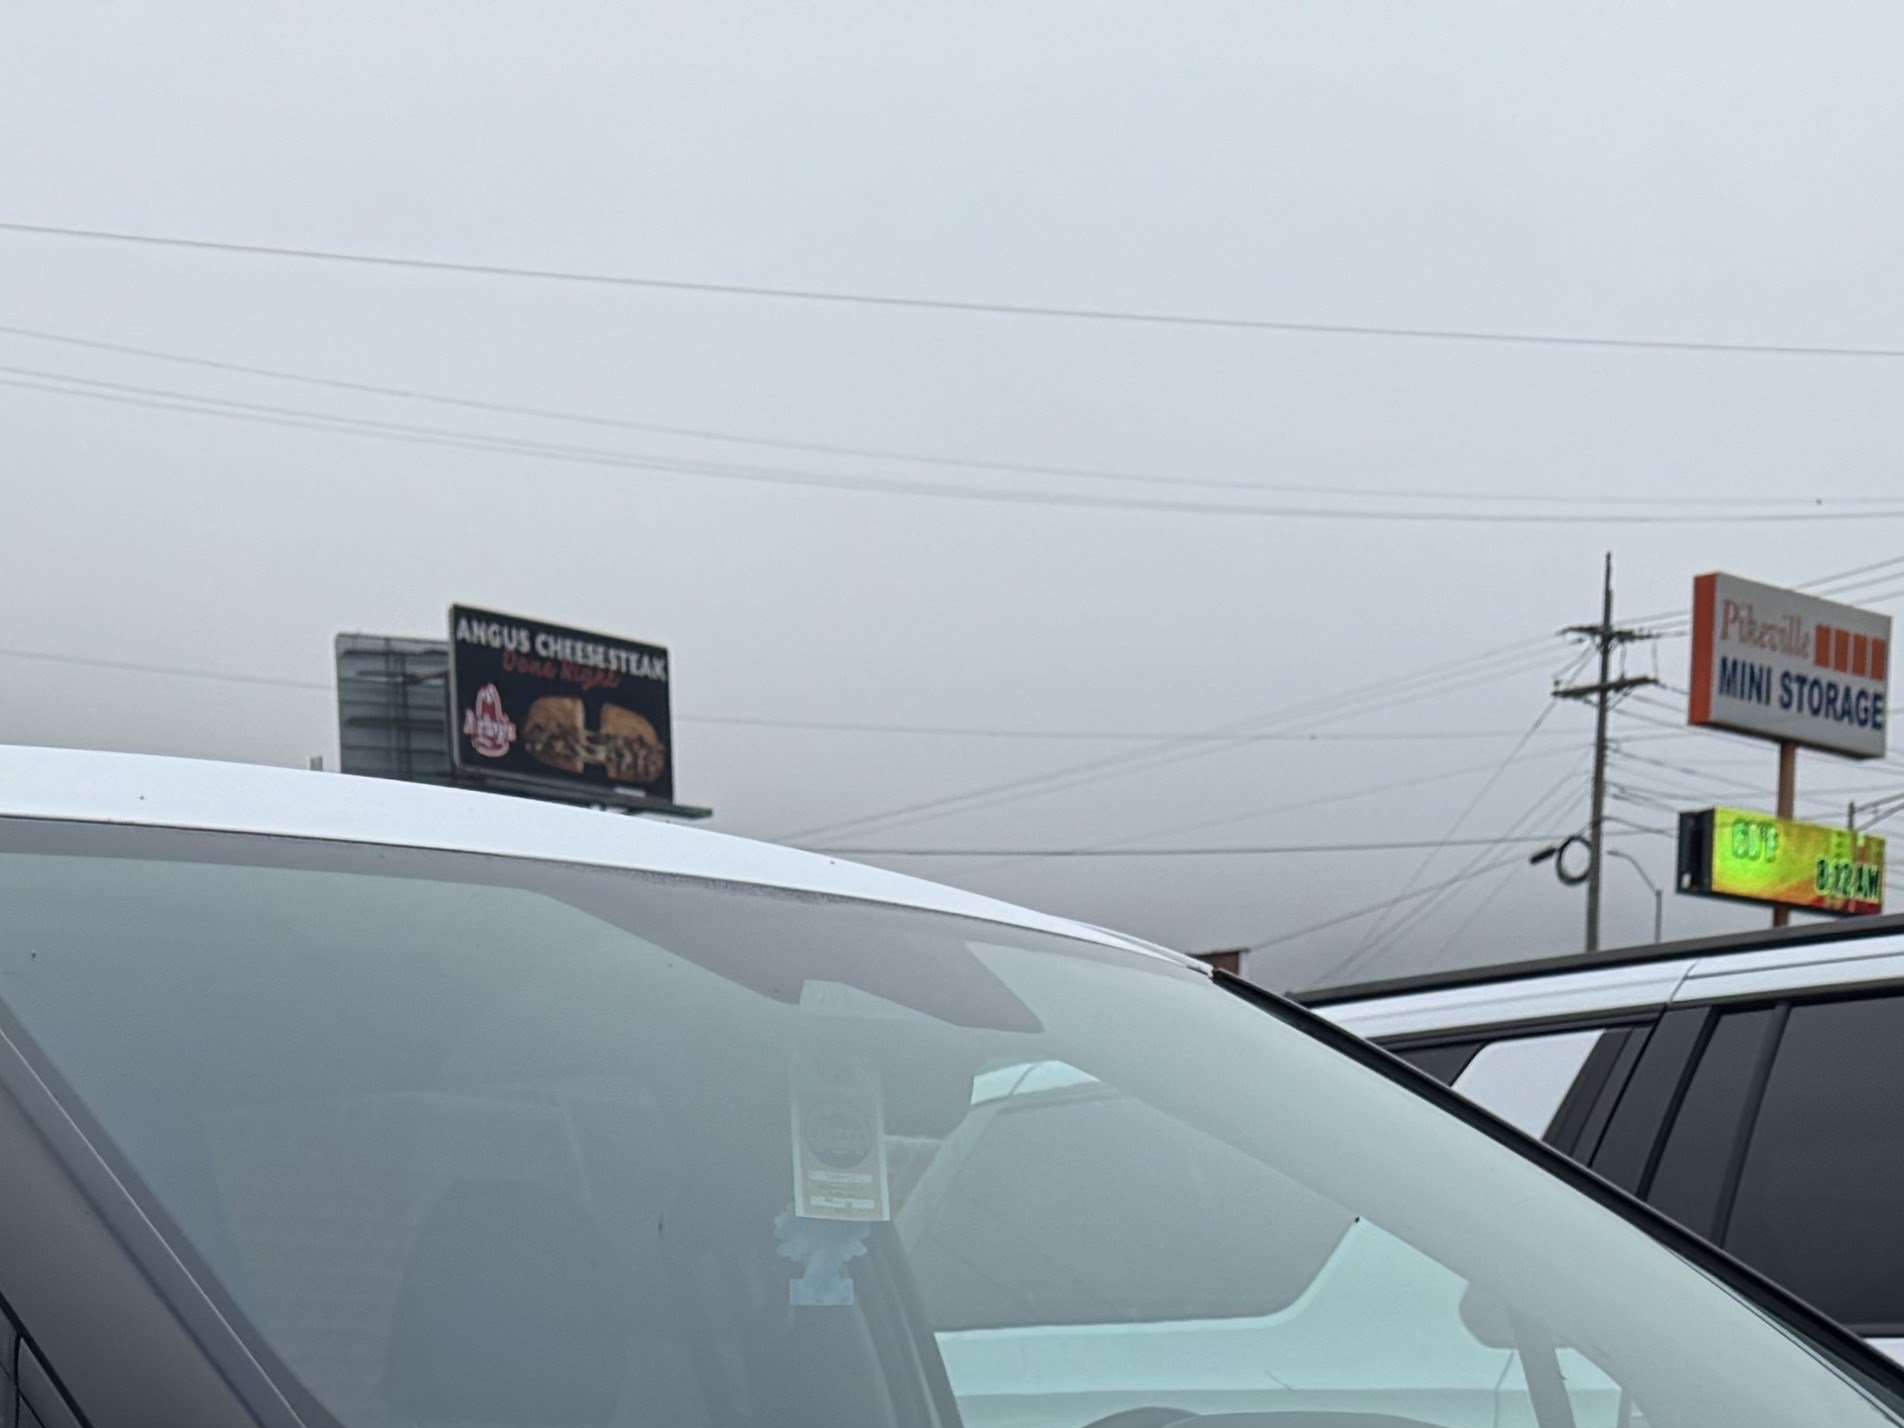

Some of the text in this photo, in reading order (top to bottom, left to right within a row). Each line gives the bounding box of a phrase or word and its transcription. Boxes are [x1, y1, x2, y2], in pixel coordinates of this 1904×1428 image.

[456, 616, 667, 681] ANGUS CHEESESTEAK
[1718, 655, 1886, 732] MINI STORAGE
